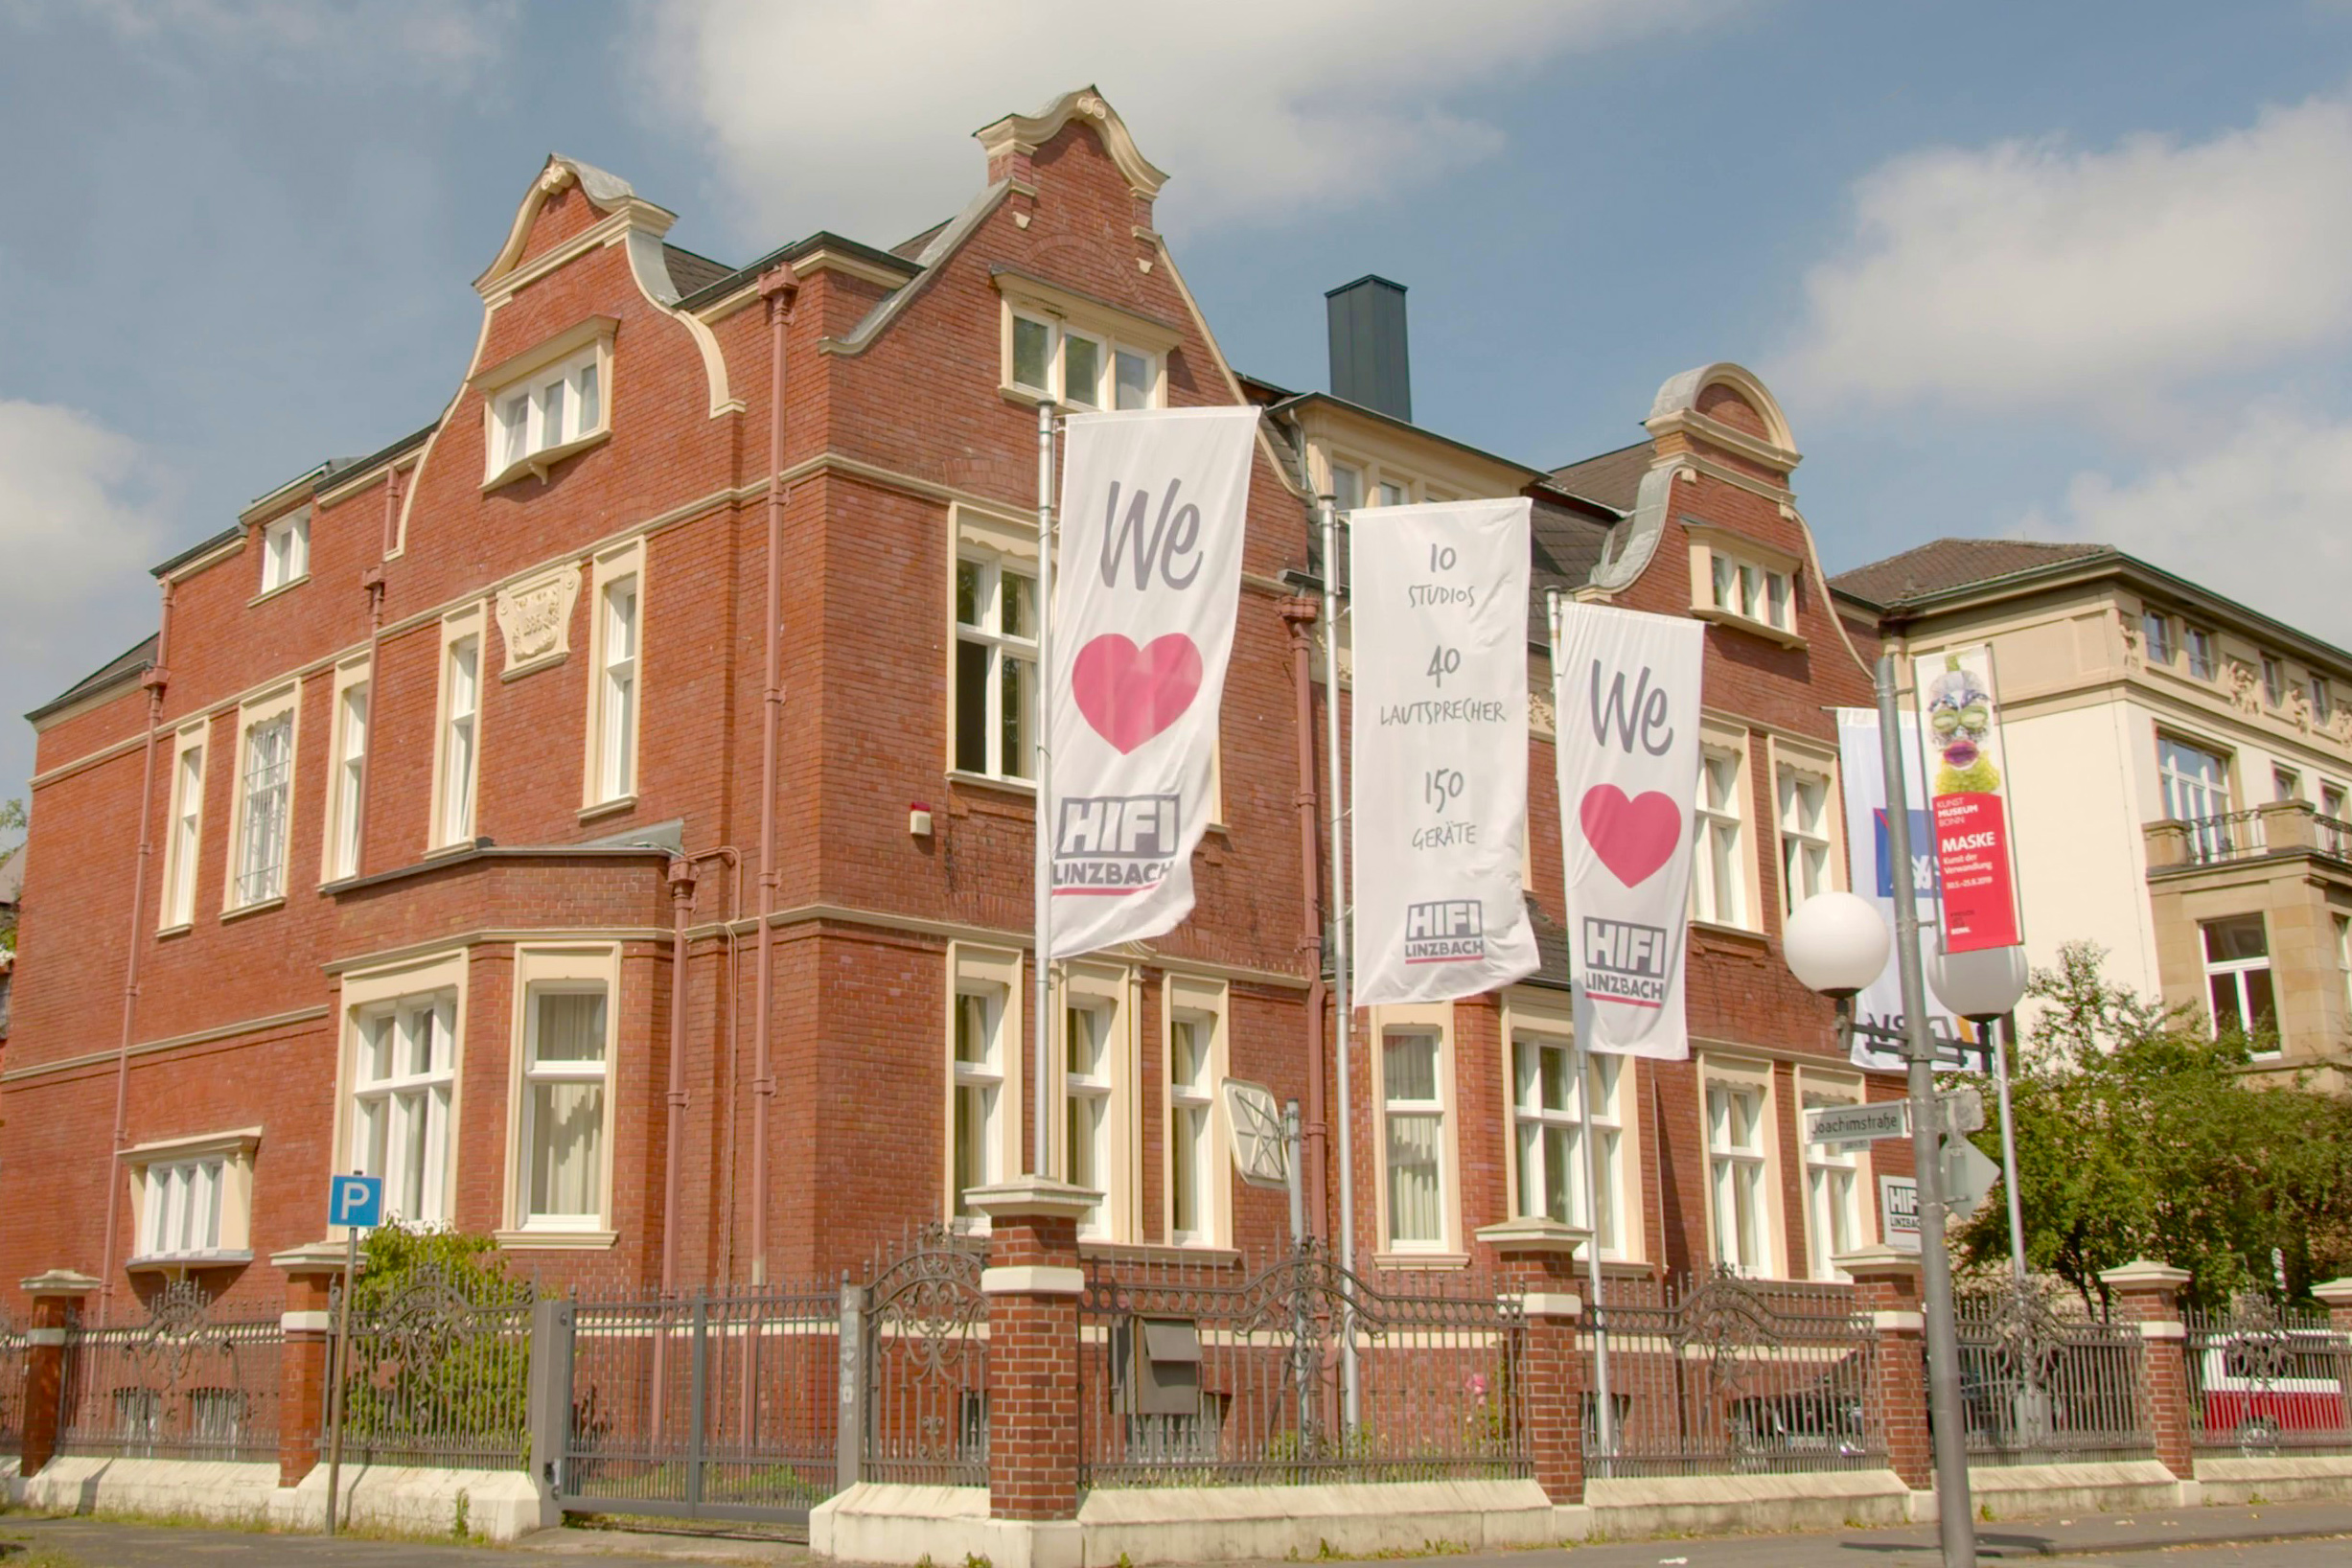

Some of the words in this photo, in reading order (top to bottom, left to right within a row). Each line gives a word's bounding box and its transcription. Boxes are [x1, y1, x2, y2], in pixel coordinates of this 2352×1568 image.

[1101, 478, 1204, 591] We
[1430, 542, 1457, 573] 10
[1408, 584, 1475, 608] STUDIOS
[1426, 645, 1461, 688] 40
[1380, 698, 1507, 726] LAUTSPRECHER
[1591, 658, 1673, 756] We
[1425, 768, 1464, 814] 150
[1936, 796, 1965, 809] KUNST
[1059, 797, 1176, 855] HIFI
[1938, 804, 1979, 818] MUSEUM
[1938, 817, 1966, 828] BONN
[1412, 820, 1477, 851] GERÄTE
[1942, 831, 1996, 854] MASKE
[1408, 902, 1482, 939] HIFI
[1405, 939, 1484, 957] LINZBACH
[1586, 920, 1665, 975] HIFI
[1585, 971, 1664, 1000] LINZBACH
[1811, 1112, 1898, 1135] Joachimstraße
[340, 1182, 371, 1220] P
[1888, 1186, 1918, 1214] HIF
